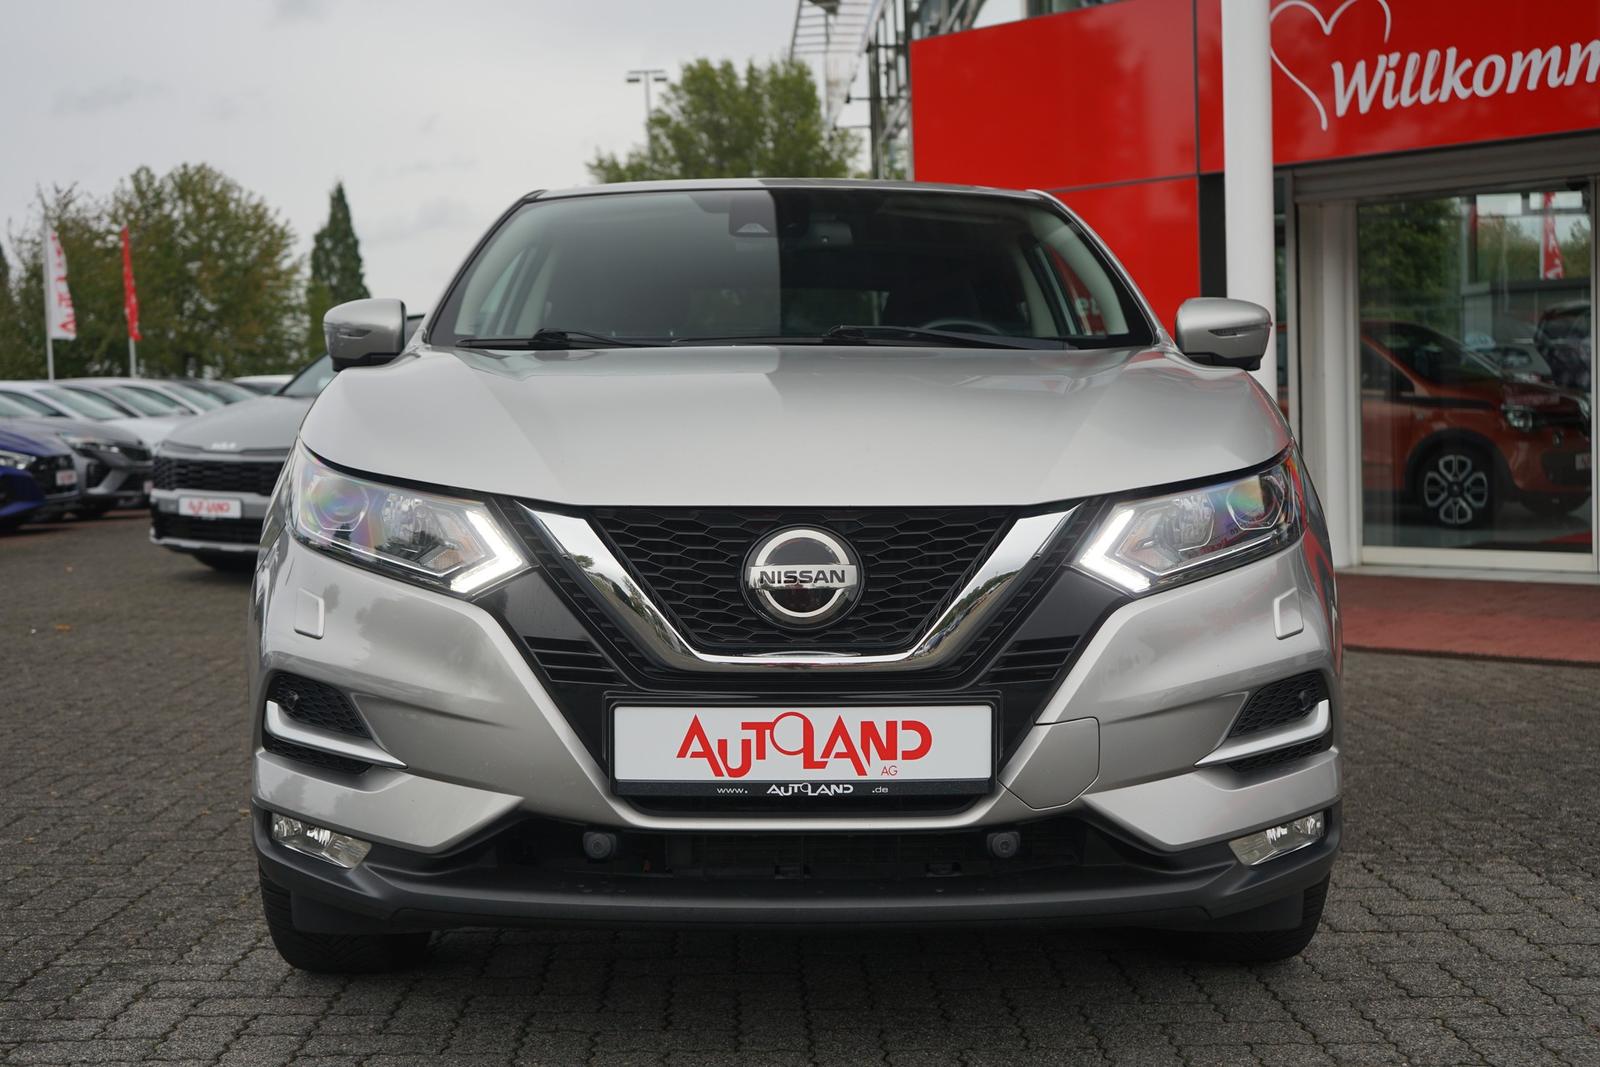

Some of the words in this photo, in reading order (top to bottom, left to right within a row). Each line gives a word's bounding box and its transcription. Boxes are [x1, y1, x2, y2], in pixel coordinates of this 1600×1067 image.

[1331, 38, 1600, 118] Willkomm
[760, 569, 846, 585] NISSAN
[676, 711, 933, 778] AUTOLAND
[880, 765, 899, 777] AG
[716, 786, 748, 795] www.
[766, 782, 854, 797] AUTOLAND
[871, 785, 889, 794] .de
